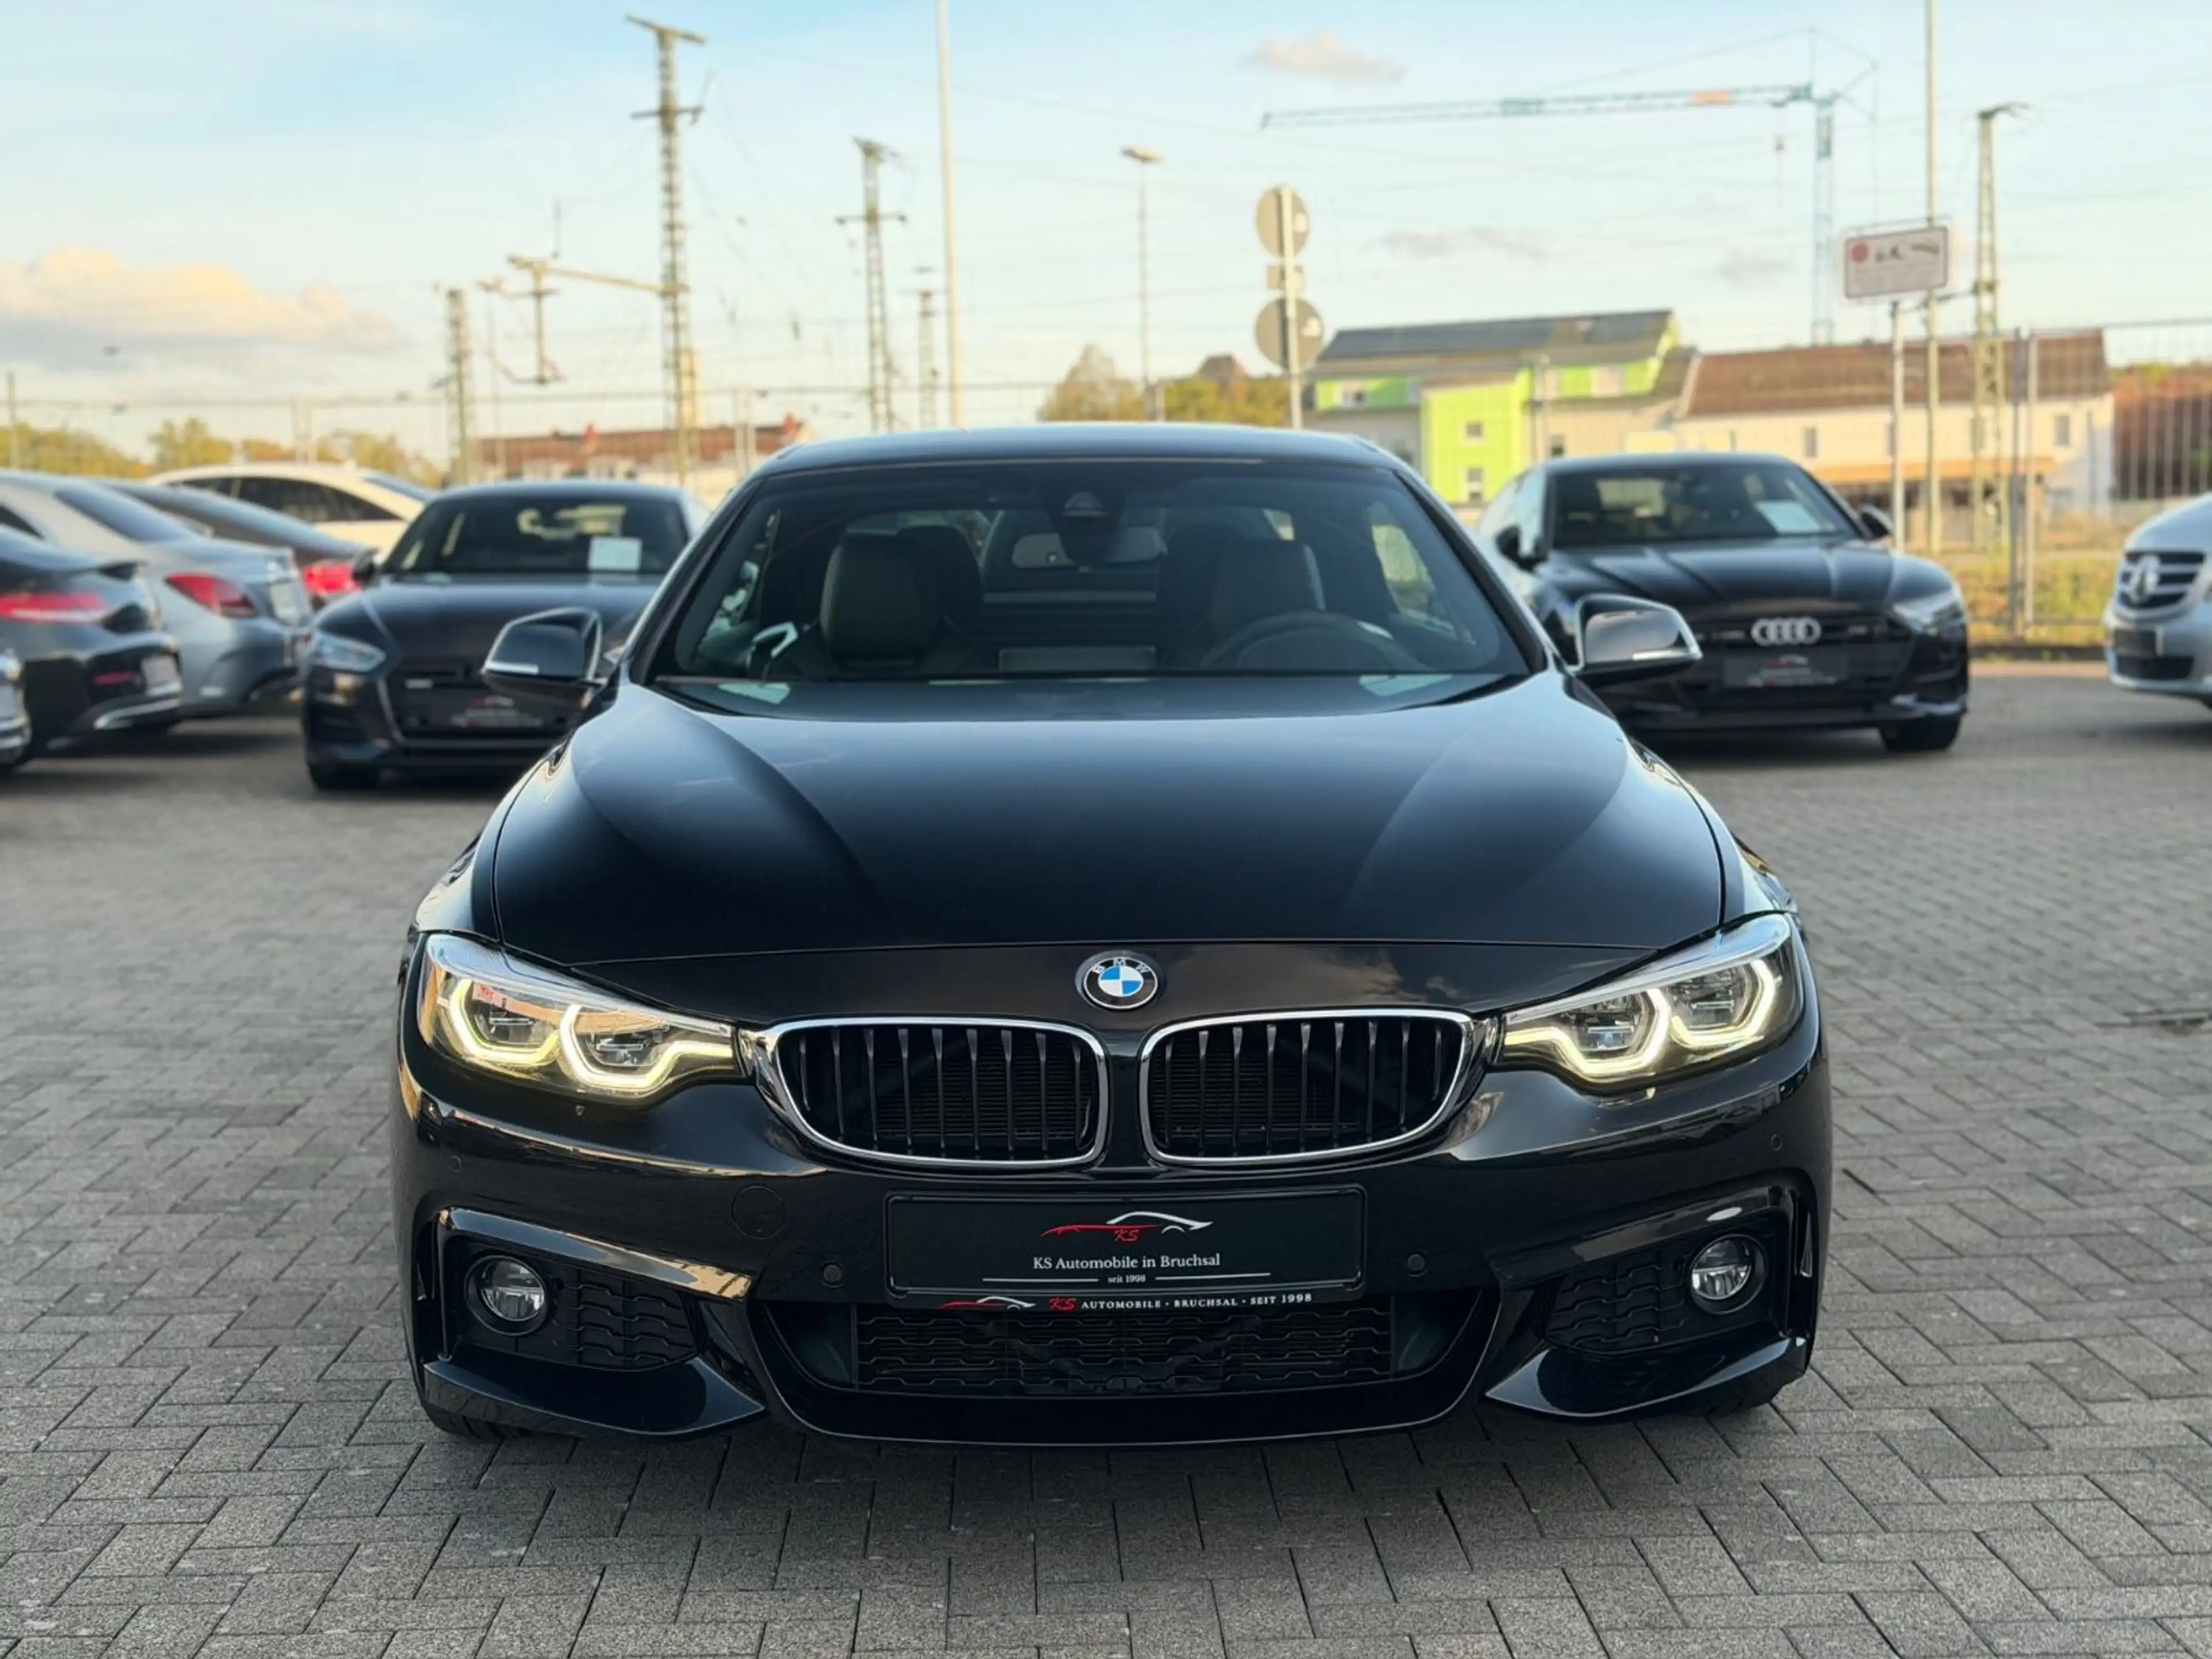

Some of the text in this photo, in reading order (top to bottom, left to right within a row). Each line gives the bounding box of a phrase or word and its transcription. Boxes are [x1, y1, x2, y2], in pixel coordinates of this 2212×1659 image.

[1092, 957, 1150, 974] BMW
[1033, 1253, 1221, 1269] KS Automobile in Bruchsal
[1108, 1274, 1146, 1283] seit 1998
[1081, 1300, 1161, 1309] AUTOMOBILE
[1174, 1298, 1238, 1308] BRUCHSAL
[1250, 1296, 1277, 1305] SEIT
[1282, 1293, 1312, 1304] 1998
